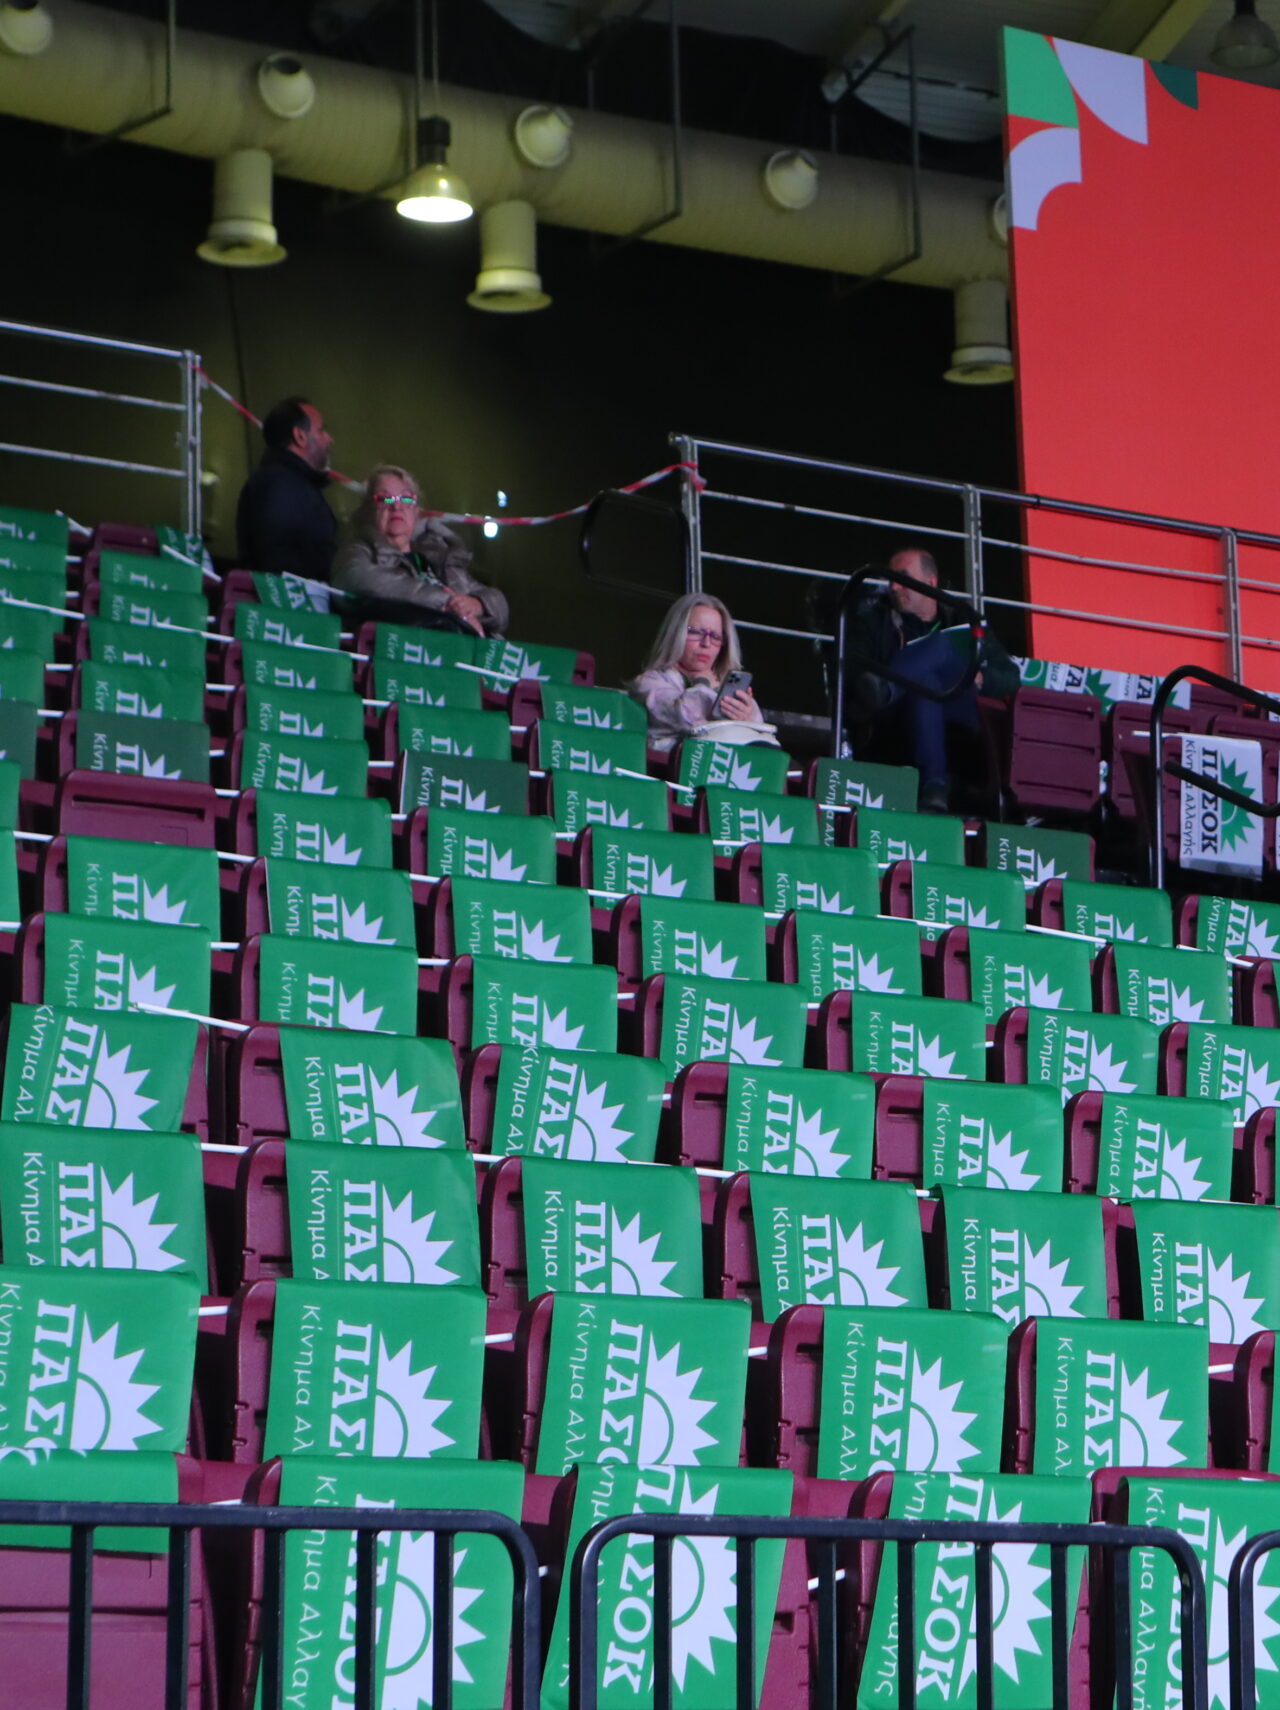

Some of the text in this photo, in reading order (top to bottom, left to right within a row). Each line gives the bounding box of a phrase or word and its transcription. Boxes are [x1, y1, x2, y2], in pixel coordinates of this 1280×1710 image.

[45, 1017, 98, 1126] ΠΑΣ
[304, 1057, 326, 1136] Κίνημα
[534, 1058, 578, 1159] ΠΑΣ
[736, 1078, 756, 1152] Κίνημα
[1109, 1105, 1127, 1179] Κίνημα
[21, 1152, 45, 1243] Κίνημα
[59, 1162, 96, 1267] ΠΑΣ
[309, 1170, 330, 1258] Κίνημα
[541, 1190, 564, 1276] Κίνημα
[773, 1207, 790, 1290] Κίνημα
[963, 1219, 979, 1300] Κίνημα
[991, 1229, 1020, 1329] ΠΑΣ
[1151, 1232, 1167, 1312] Κίνημα
[24, 1299, 77, 1448] ΠΑΣ
[295, 1305, 320, 1405] Κίνημα
[329, 1320, 373, 1456] ΠΑΣ
[570, 1303, 596, 1399] Κίνημα
[598, 1319, 643, 1474] ΠΑΣ
[842, 1322, 864, 1415] Κίνημα
[1053, 1337, 1075, 1427] Κίνημα
[870, 1339, 907, 1476] ΠΑΣ
[1086, 1353, 1114, 1478] ΠΑΣ
[286, 1602, 322, 1708] Αλλαγ
